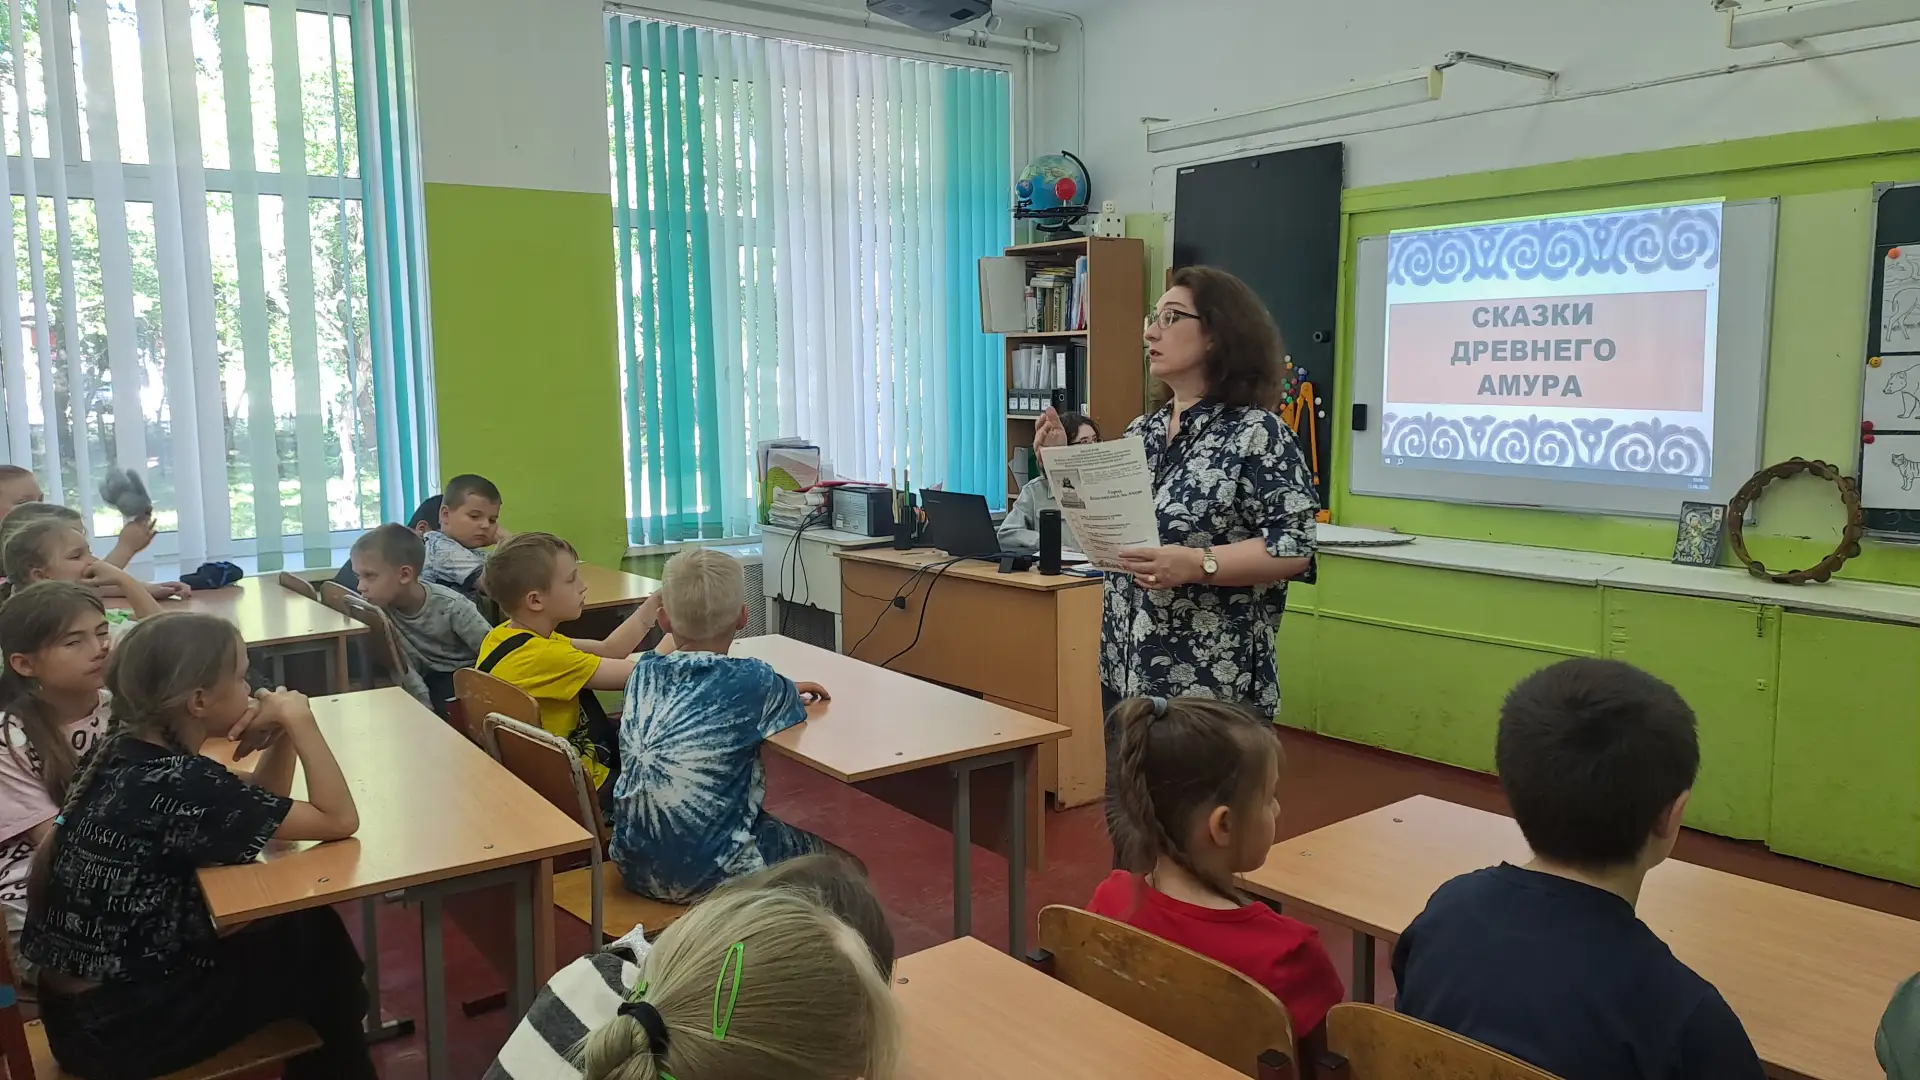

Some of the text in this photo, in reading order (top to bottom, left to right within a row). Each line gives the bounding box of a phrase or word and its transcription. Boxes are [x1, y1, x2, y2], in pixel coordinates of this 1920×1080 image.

[1472, 302, 1593, 328] СКАЗКИ
[1450, 338, 1616, 366] ДРЕВНЕГО
[1477, 374, 1583, 397] АМУРА
